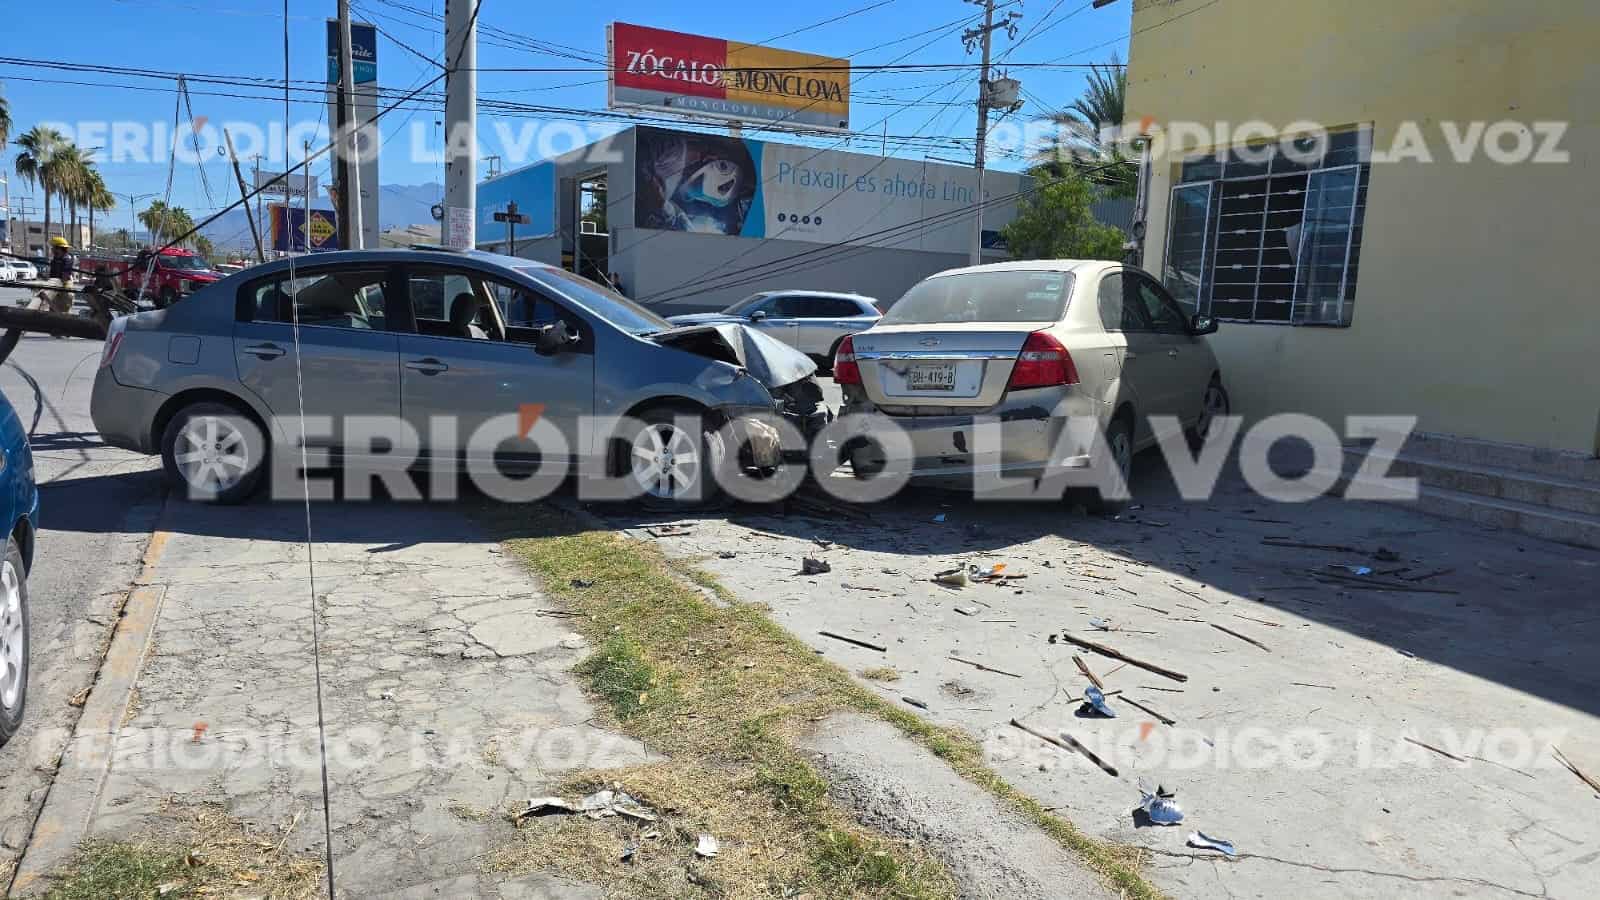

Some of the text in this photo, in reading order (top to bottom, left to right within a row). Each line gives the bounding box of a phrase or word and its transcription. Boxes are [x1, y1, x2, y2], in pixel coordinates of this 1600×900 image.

[626, 48, 843, 104] ZÓCALO MONCLOVA
[778, 161, 848, 191] Praxair
[855, 175, 876, 193] es
[883, 170, 936, 200] ahora
